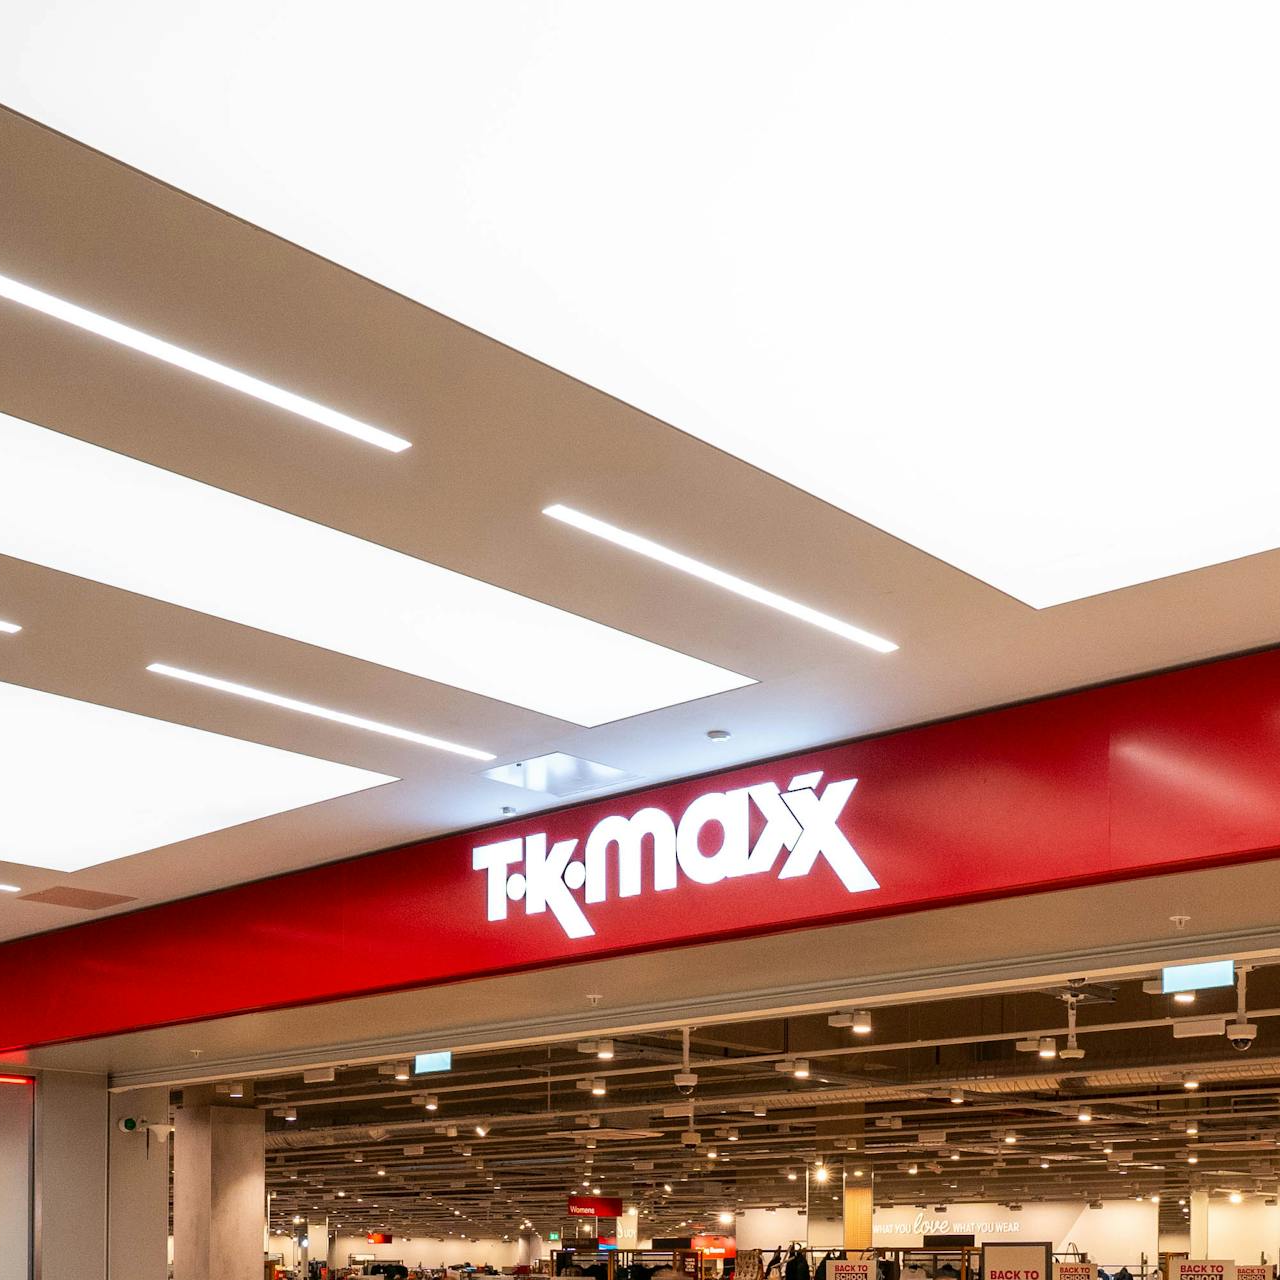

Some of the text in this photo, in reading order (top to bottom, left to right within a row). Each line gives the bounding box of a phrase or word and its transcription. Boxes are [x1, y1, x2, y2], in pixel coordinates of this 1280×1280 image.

[570, 1206, 595, 1214] Womens
[873, 1212, 1020, 1234] WHAT YOU love WHAT YOU WEAR
[835, 1264, 868, 1272] BACK TO
[1180, 1264, 1224, 1273] BACK TO
[835, 1273, 867, 1280] SCHOOL
[990, 1270, 1039, 1280] BACK TO
